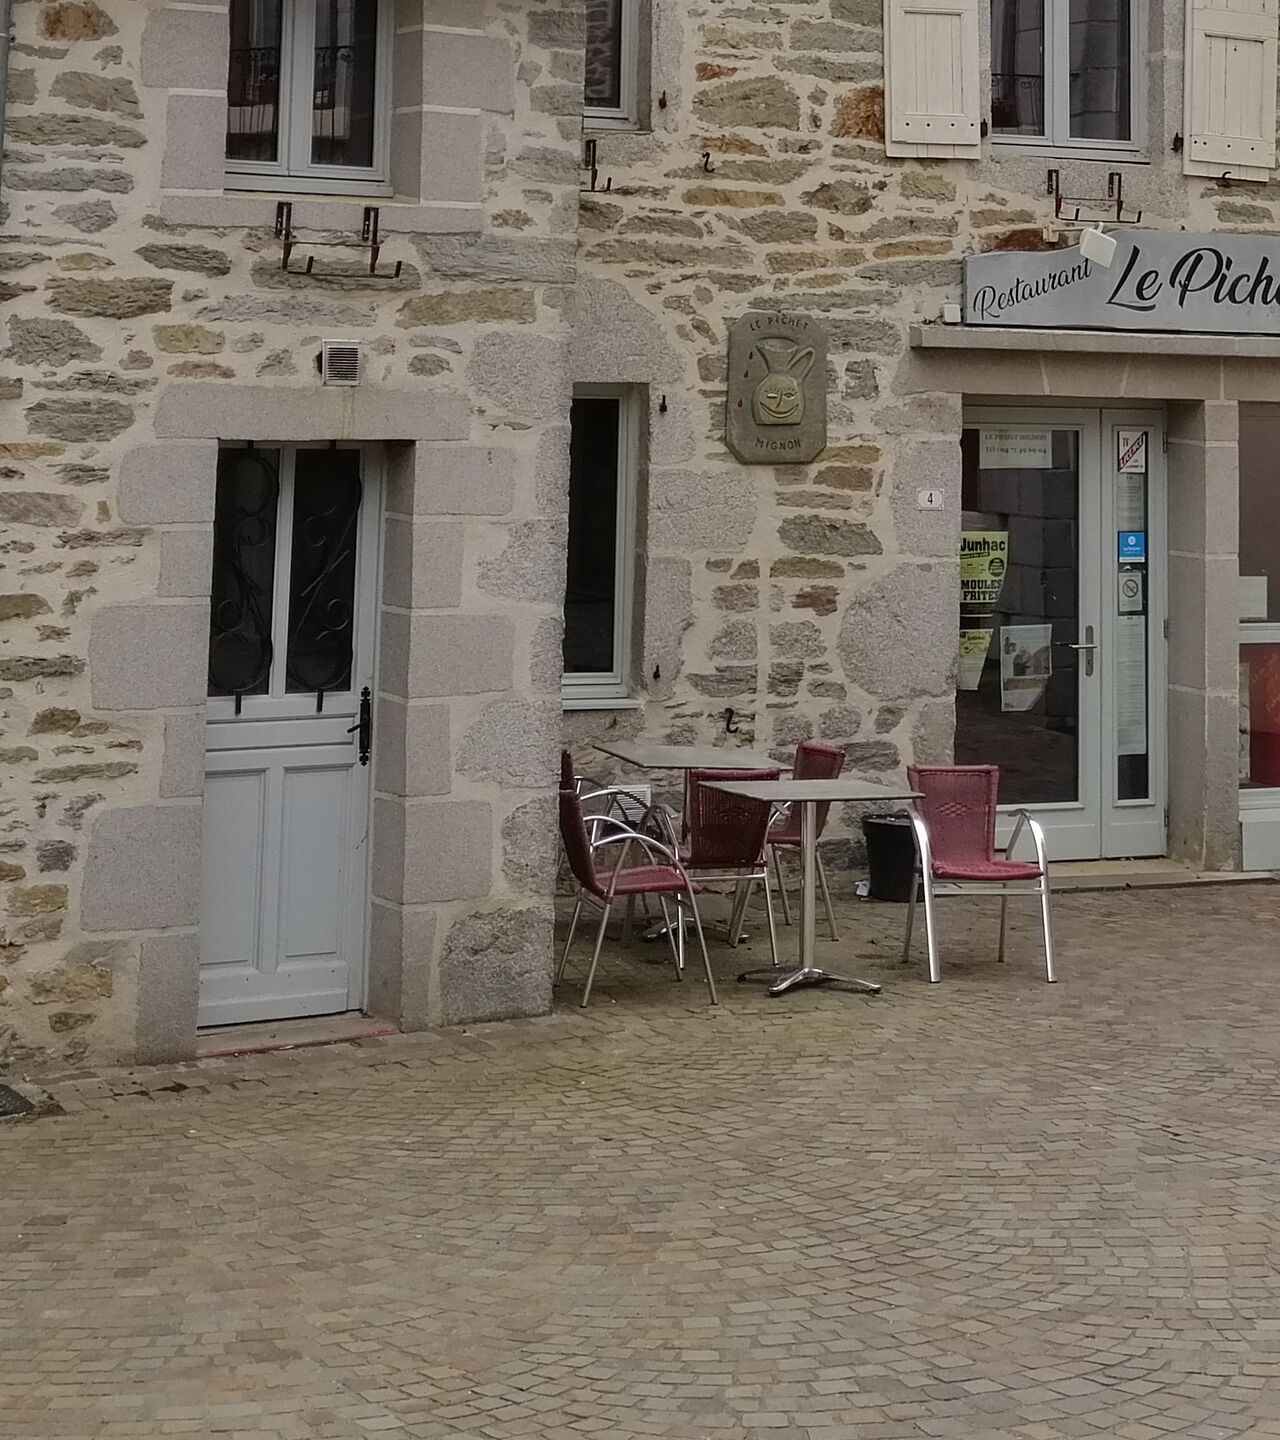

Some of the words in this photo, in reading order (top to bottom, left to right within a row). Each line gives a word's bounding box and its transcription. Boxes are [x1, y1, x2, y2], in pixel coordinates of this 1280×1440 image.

[1106, 245, 1163, 311] Le
[973, 257, 1092, 320] Restaurant
[749, 319, 762, 332] LE
[768, 316, 809, 330] PICHET
[754, 436, 802, 451] MIGNON
[926, 492, 934, 505] 4
[960, 536, 1006, 553] Junhac
[960, 578, 1003, 591] MOULES
[963, 591, 1001, 602] FRITES
